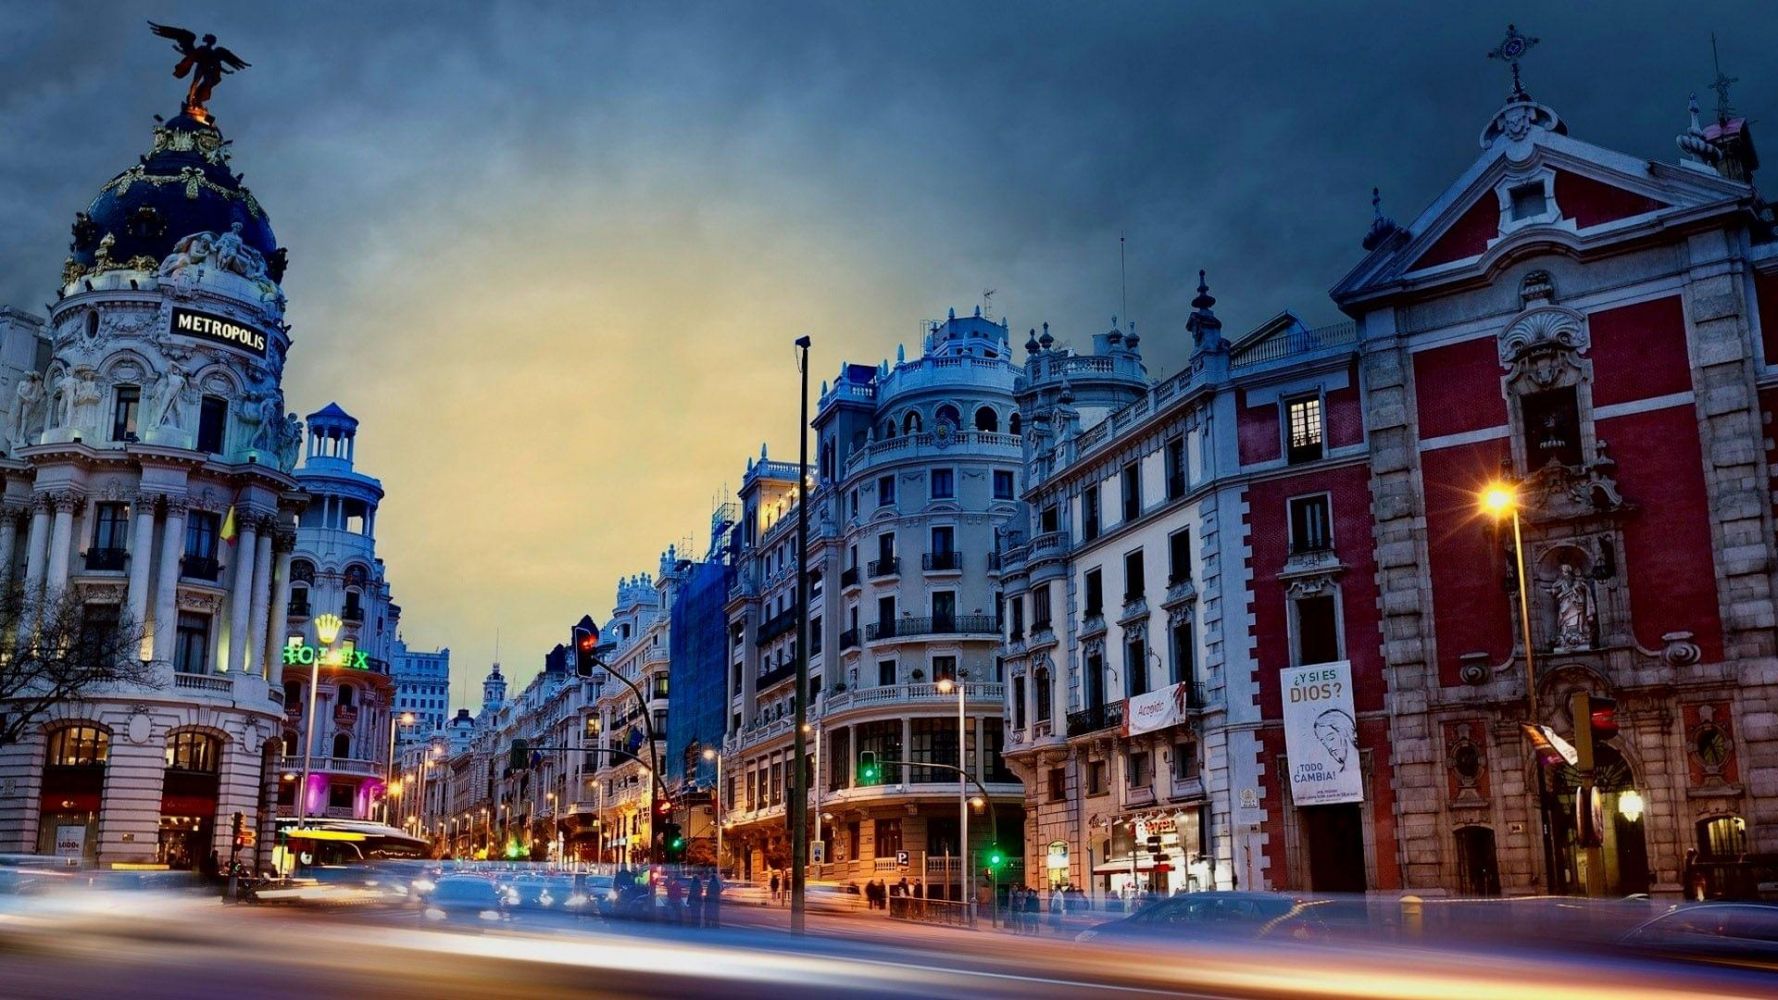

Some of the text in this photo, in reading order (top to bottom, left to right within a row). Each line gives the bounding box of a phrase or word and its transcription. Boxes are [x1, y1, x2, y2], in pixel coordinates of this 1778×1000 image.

[178, 313, 265, 351] METROPOLIS
[282, 646, 369, 669] ROLEX
[1294, 670, 1336, 686] ¿Y SI ES
[1290, 682, 1342, 703] DIOS?
[1296, 762, 1323, 774] ¡TODO
[1294, 771, 1336, 783] CAMBIA!
[898, 852, 907, 863] P
